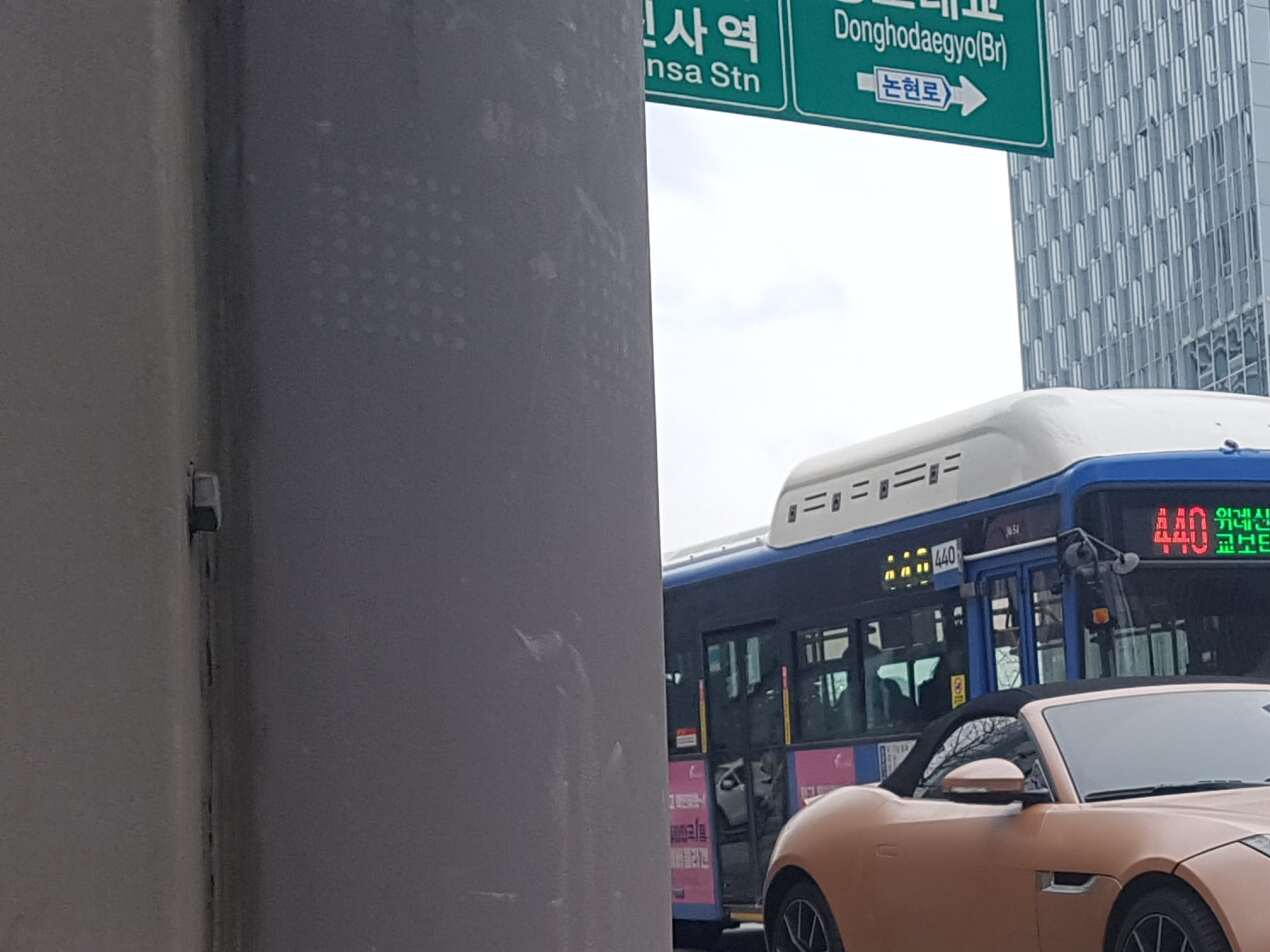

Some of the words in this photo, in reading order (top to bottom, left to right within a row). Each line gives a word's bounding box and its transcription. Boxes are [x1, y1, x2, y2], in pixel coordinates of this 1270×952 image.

[834, 8, 1008, 71] Donghodaegyo(Br)
[646, 57, 703, 84] nsa
[710, 61, 760, 93] Stn
[882, 74, 942, 102] 논현로
[1154, 507, 1208, 554] 440
[935, 546, 956, 567] 440
